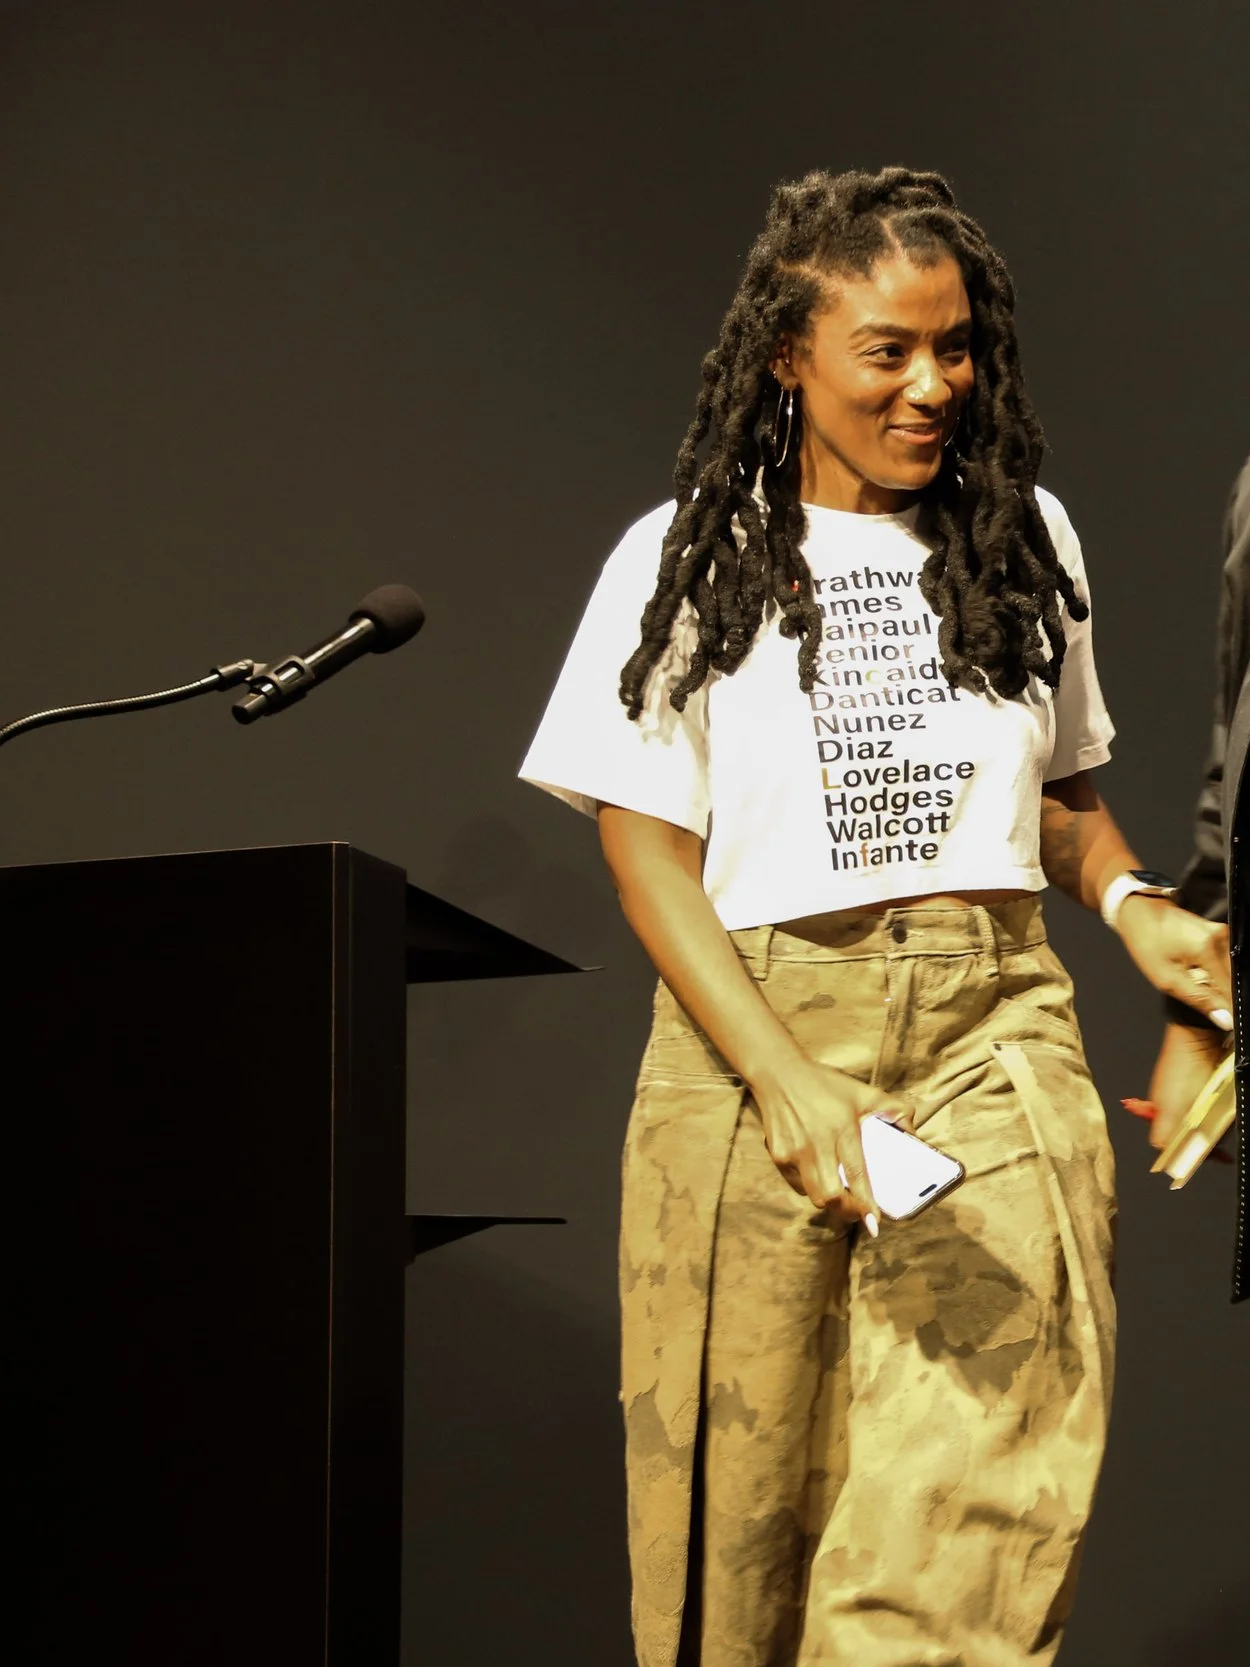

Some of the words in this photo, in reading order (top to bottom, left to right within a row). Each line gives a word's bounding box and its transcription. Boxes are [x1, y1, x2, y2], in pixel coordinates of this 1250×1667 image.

[813, 567, 923, 595] rathw
[817, 595, 903, 618] mes
[821, 613, 932, 642] aipaul
[809, 683, 961, 712] Danticat
[813, 712, 926, 736] Nunez
[816, 736, 894, 763] Diaz
[820, 759, 975, 790] Lovelace
[824, 787, 954, 816] Hodges
[826, 811, 951, 844] Walcott
[831, 839, 939, 871] Infante
